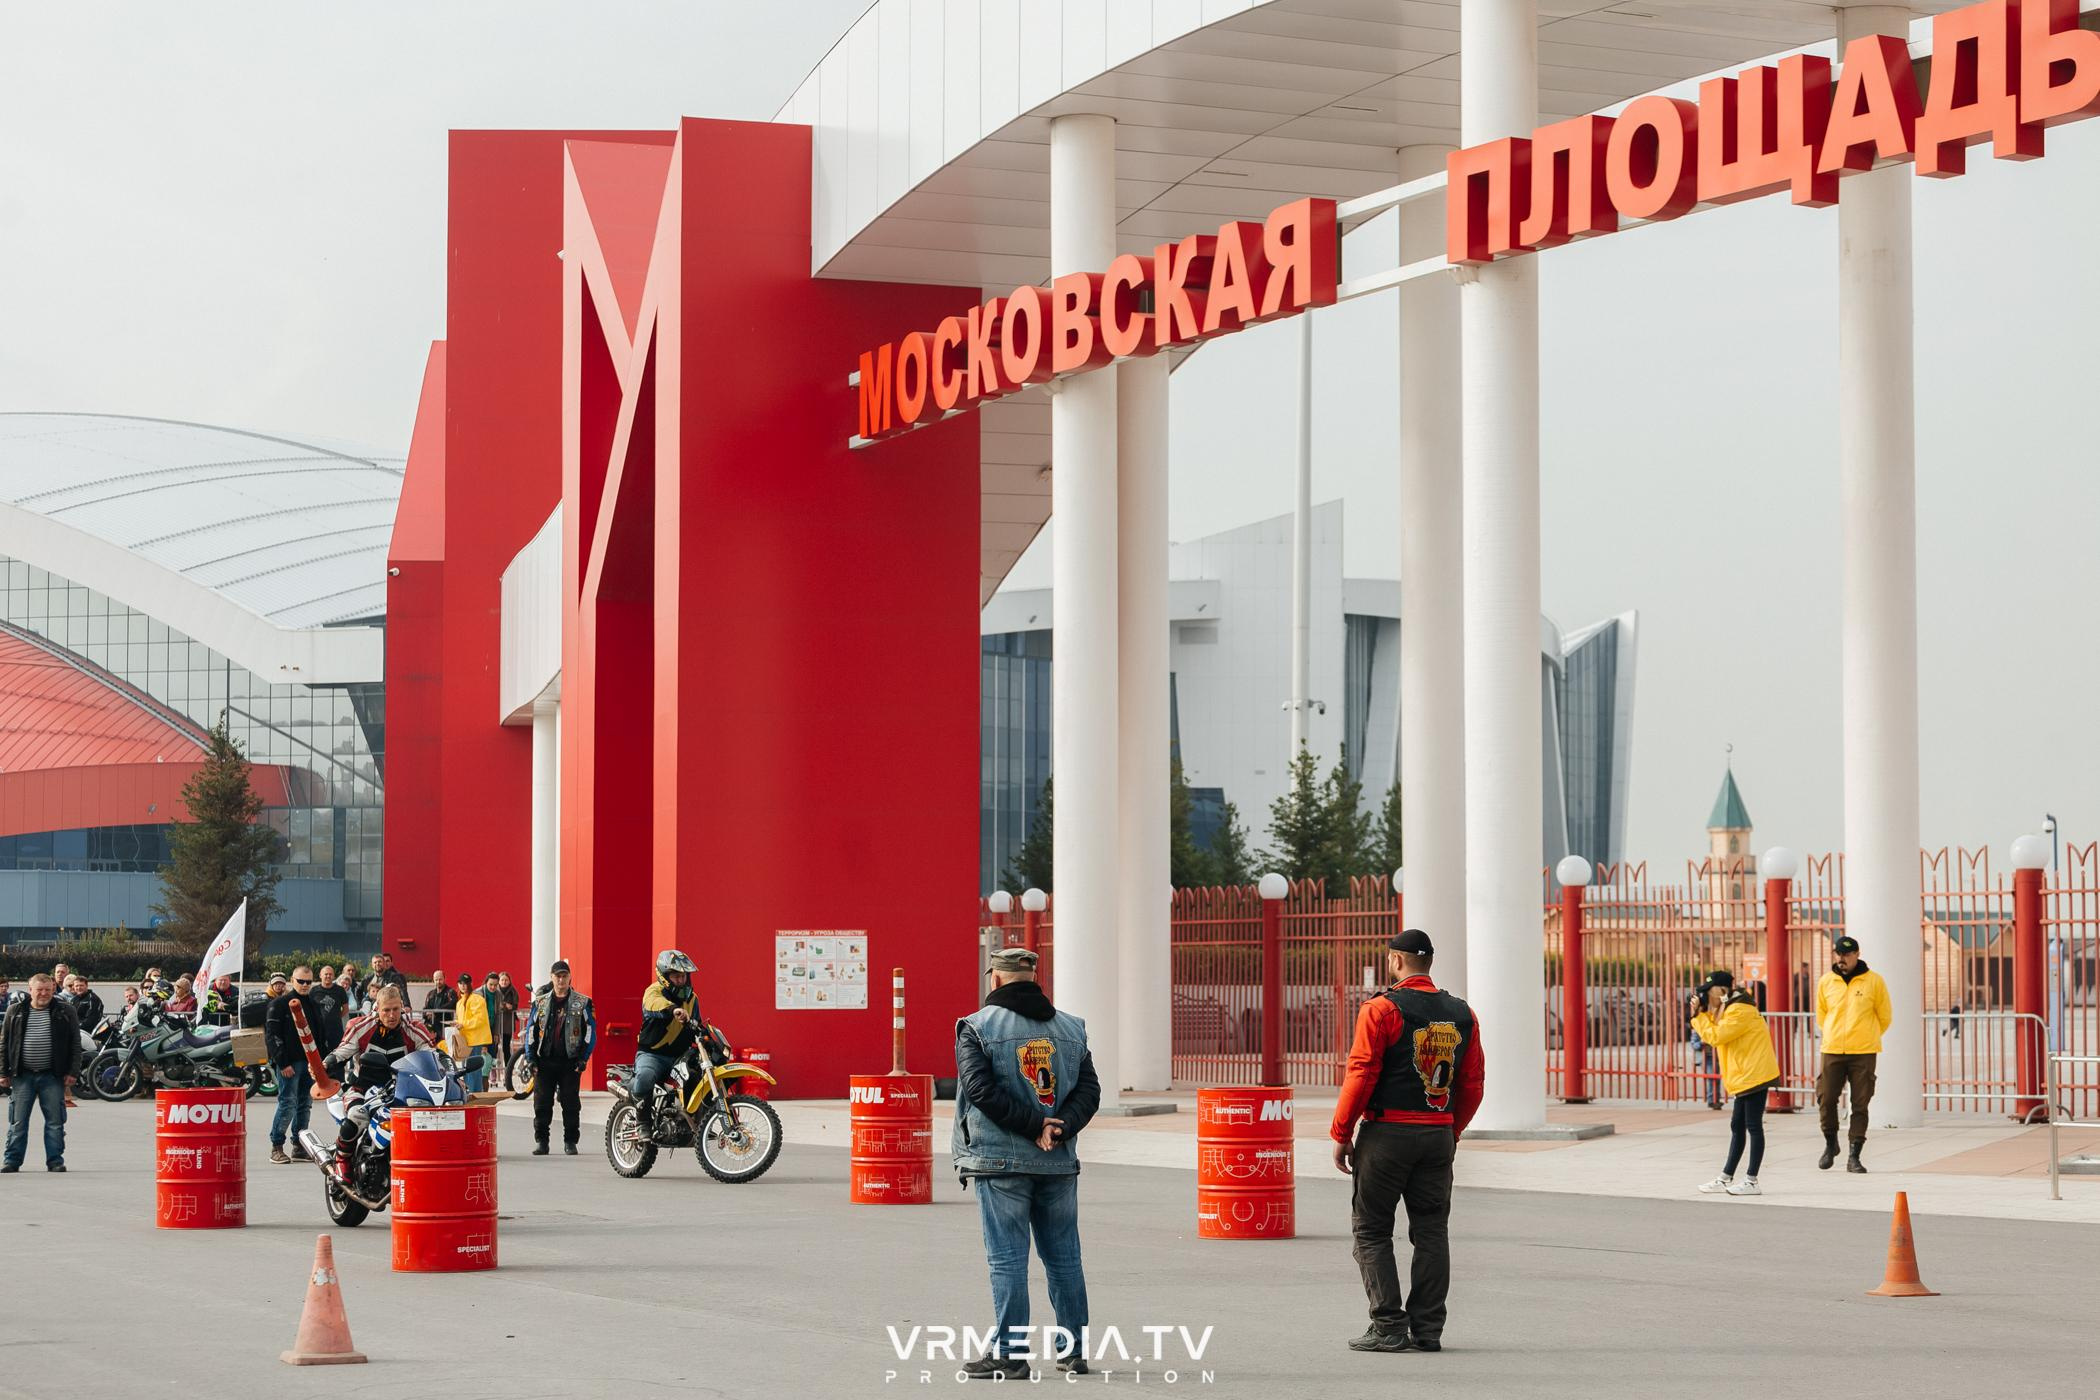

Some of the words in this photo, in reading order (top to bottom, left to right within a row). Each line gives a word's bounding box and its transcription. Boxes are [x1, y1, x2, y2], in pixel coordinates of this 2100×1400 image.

[859, 197, 1328, 439] МОСКОВСКАЯ
[1446, 0, 2100, 265] ПЛОЩАДЬ
[167, 1103, 243, 1124] MOTUL
[1215, 1107, 1251, 1115] AUTHENTIC
[1260, 1100, 1294, 1121] MO
[457, 1245, 490, 1254] SPECIALIST
